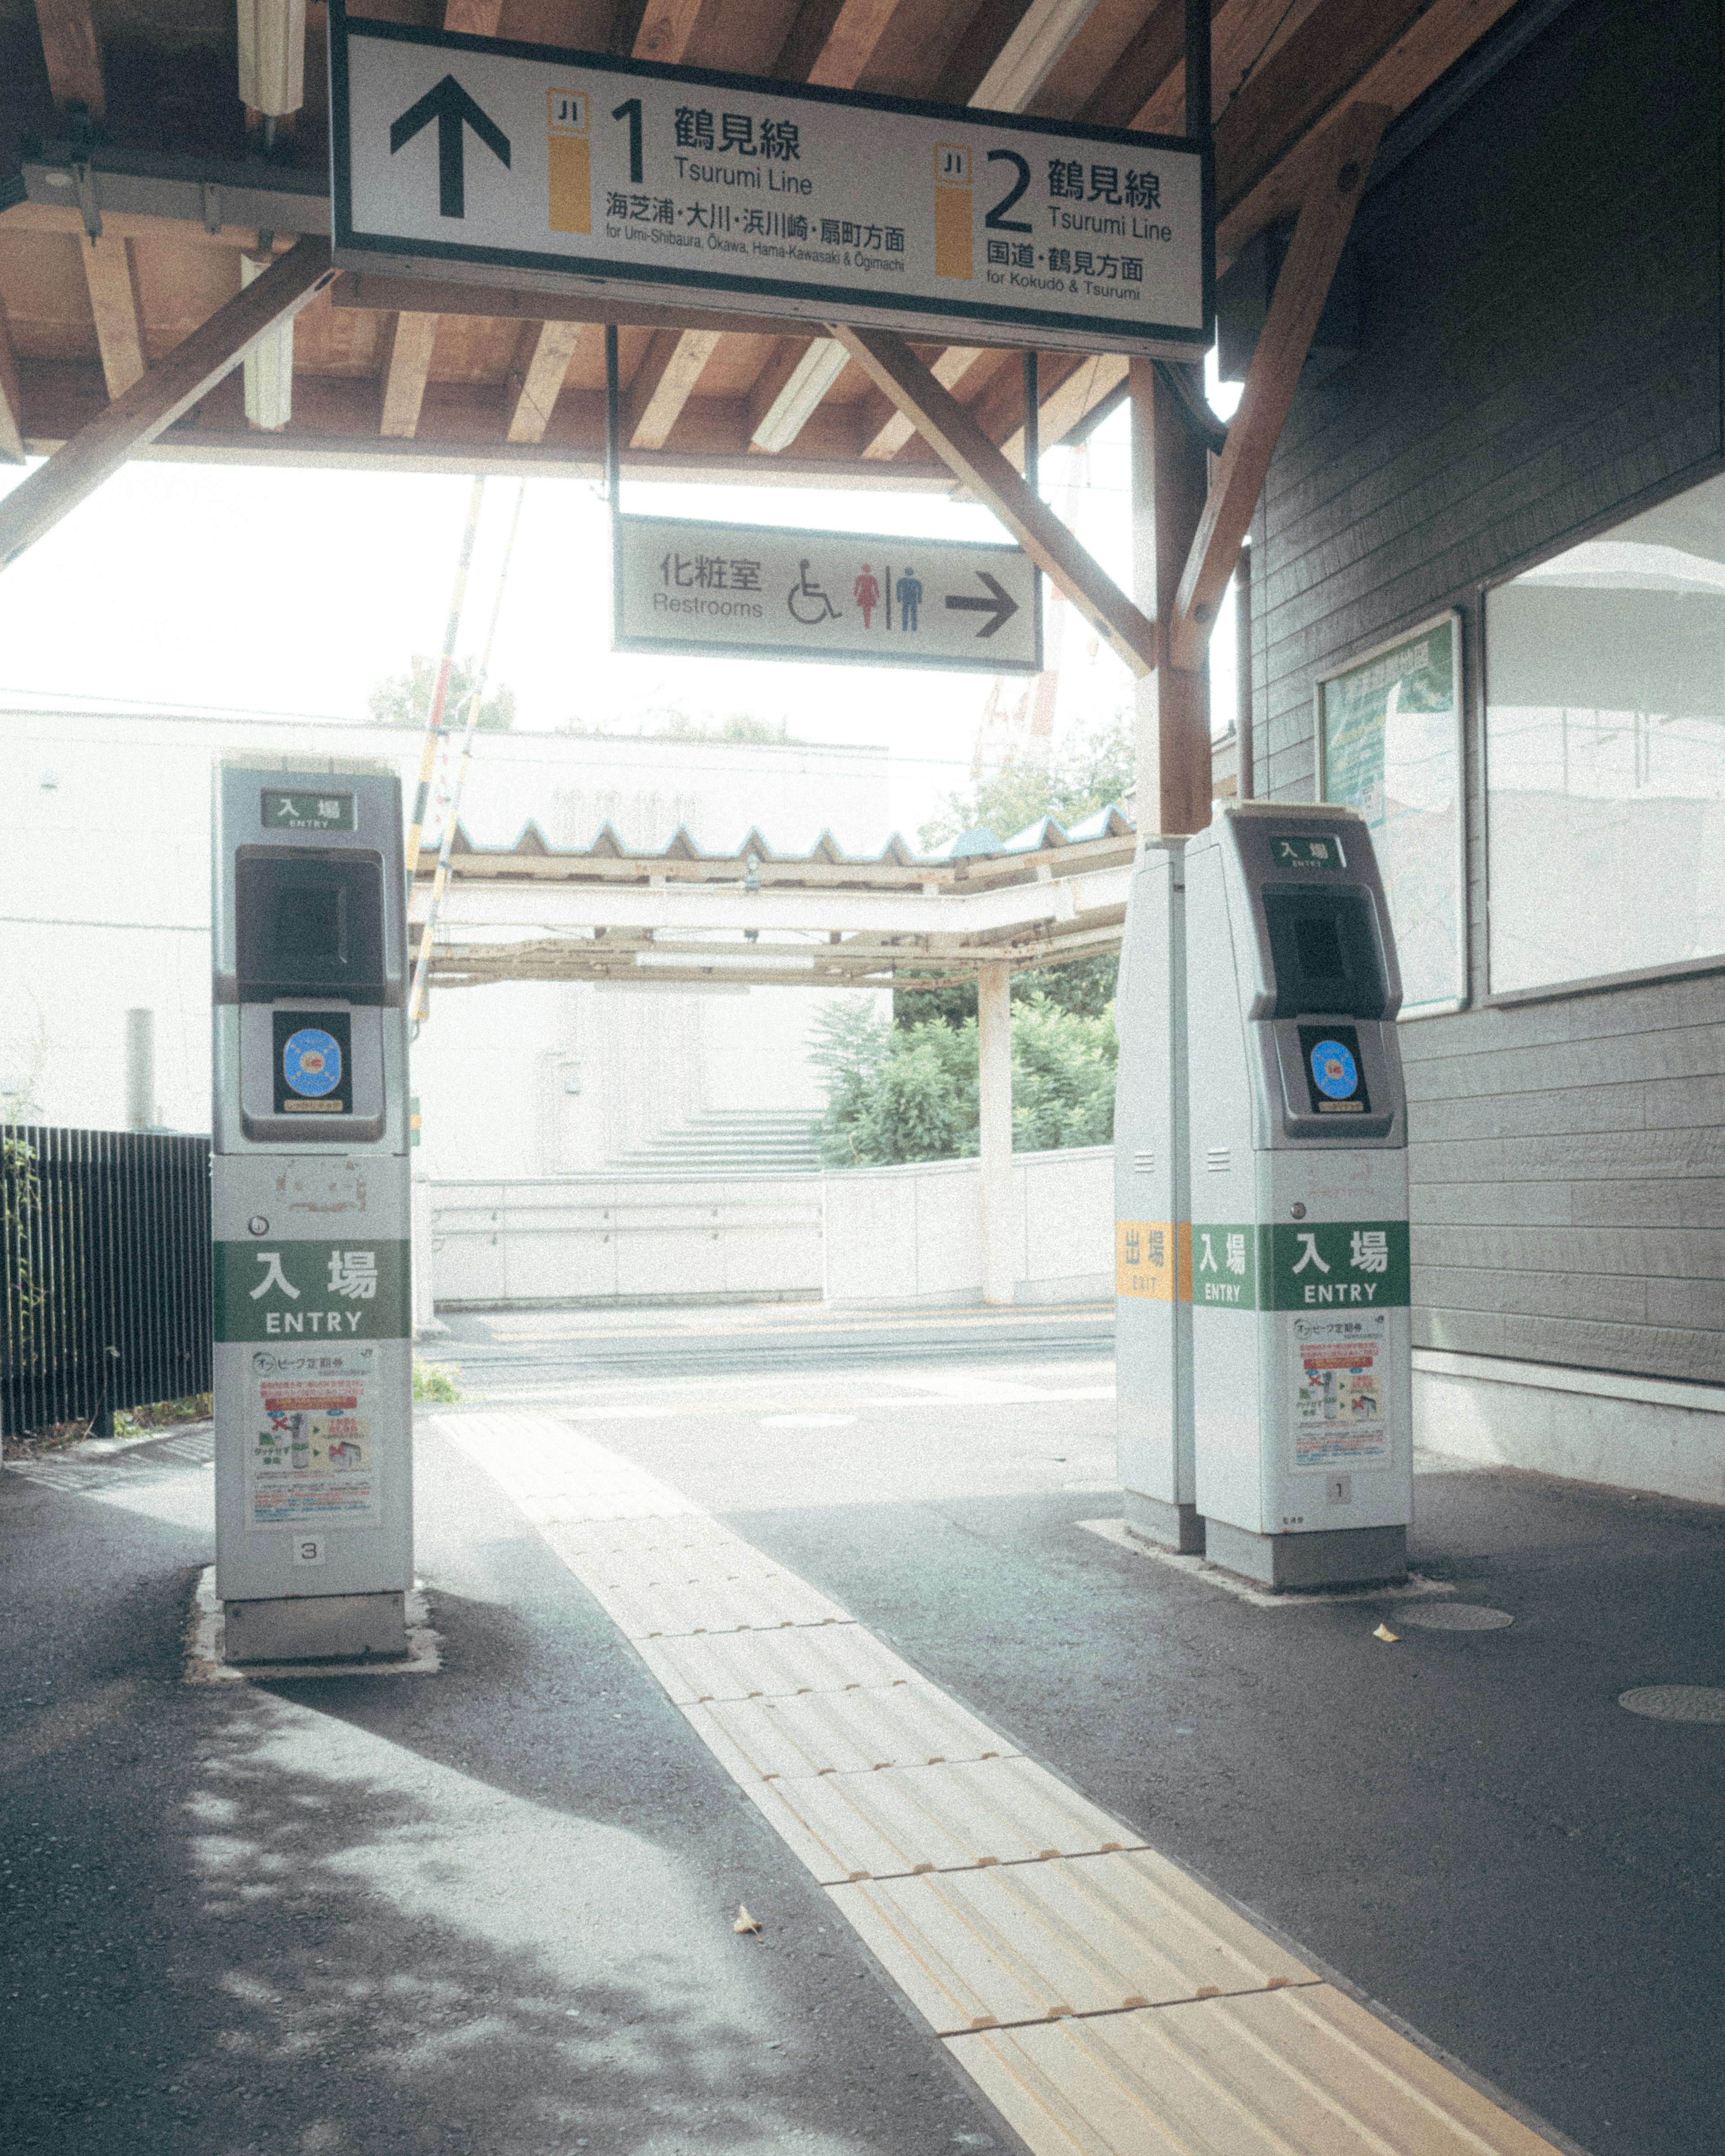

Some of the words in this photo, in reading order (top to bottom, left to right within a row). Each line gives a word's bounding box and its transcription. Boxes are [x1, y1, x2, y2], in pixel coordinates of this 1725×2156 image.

[558, 100, 578, 121] JI
[611, 98, 643, 183] 1
[674, 106, 801, 161] 鶴見線
[674, 156, 761, 189] Tsurumi
[769, 169, 813, 195] Line
[944, 153, 961, 173] JI
[985, 149, 1033, 234] 2
[1047, 158, 1162, 211] 鶴見線
[1047, 205, 1126, 237] Tsurumi
[1132, 217, 1172, 243] Line
[606, 223, 622, 238] for
[843, 252, 852, 266] &
[987, 270, 1005, 284] for
[1069, 279, 1078, 293] &
[1083, 280, 1140, 300] Tsurumi
[660, 553, 762, 592] 化粧室
[653, 592, 763, 618] Restrooms
[277, 799, 341, 819] 入場
[289, 819, 329, 828] ENTRY
[1280, 841, 1328, 859] 入場
[1199, 1232, 1246, 1275] 入場
[1292, 1230, 1389, 1275] 入場
[249, 1250, 379, 1300] 入場
[1132, 1275, 1157, 1293] EXIT
[1205, 1283, 1241, 1303] ENTRY
[1304, 1282, 1378, 1303] ENTRY
[266, 1311, 362, 1334] ENTRY
[1336, 1483, 1342, 1497] 1
[301, 1542, 318, 1560] 3
